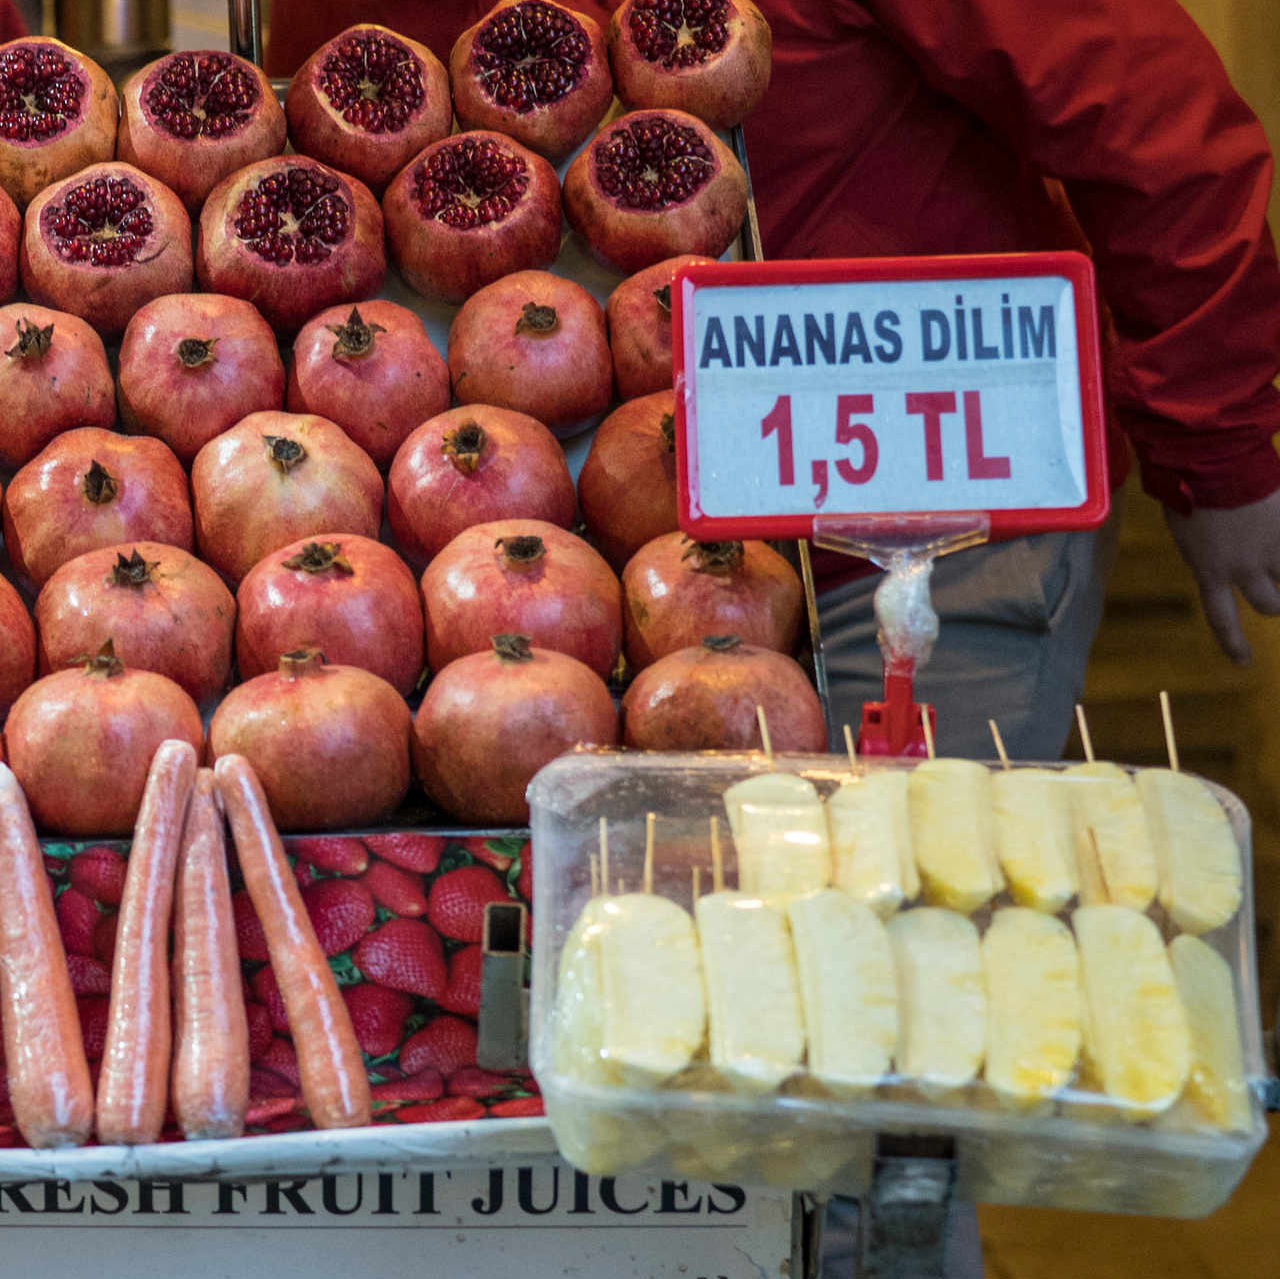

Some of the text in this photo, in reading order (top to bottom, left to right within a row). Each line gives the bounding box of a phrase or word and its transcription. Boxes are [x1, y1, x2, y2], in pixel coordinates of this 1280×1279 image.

[699, 293, 1057, 368] ANANAS DİLİM
[760, 390, 1011, 509] 1,5 TL
